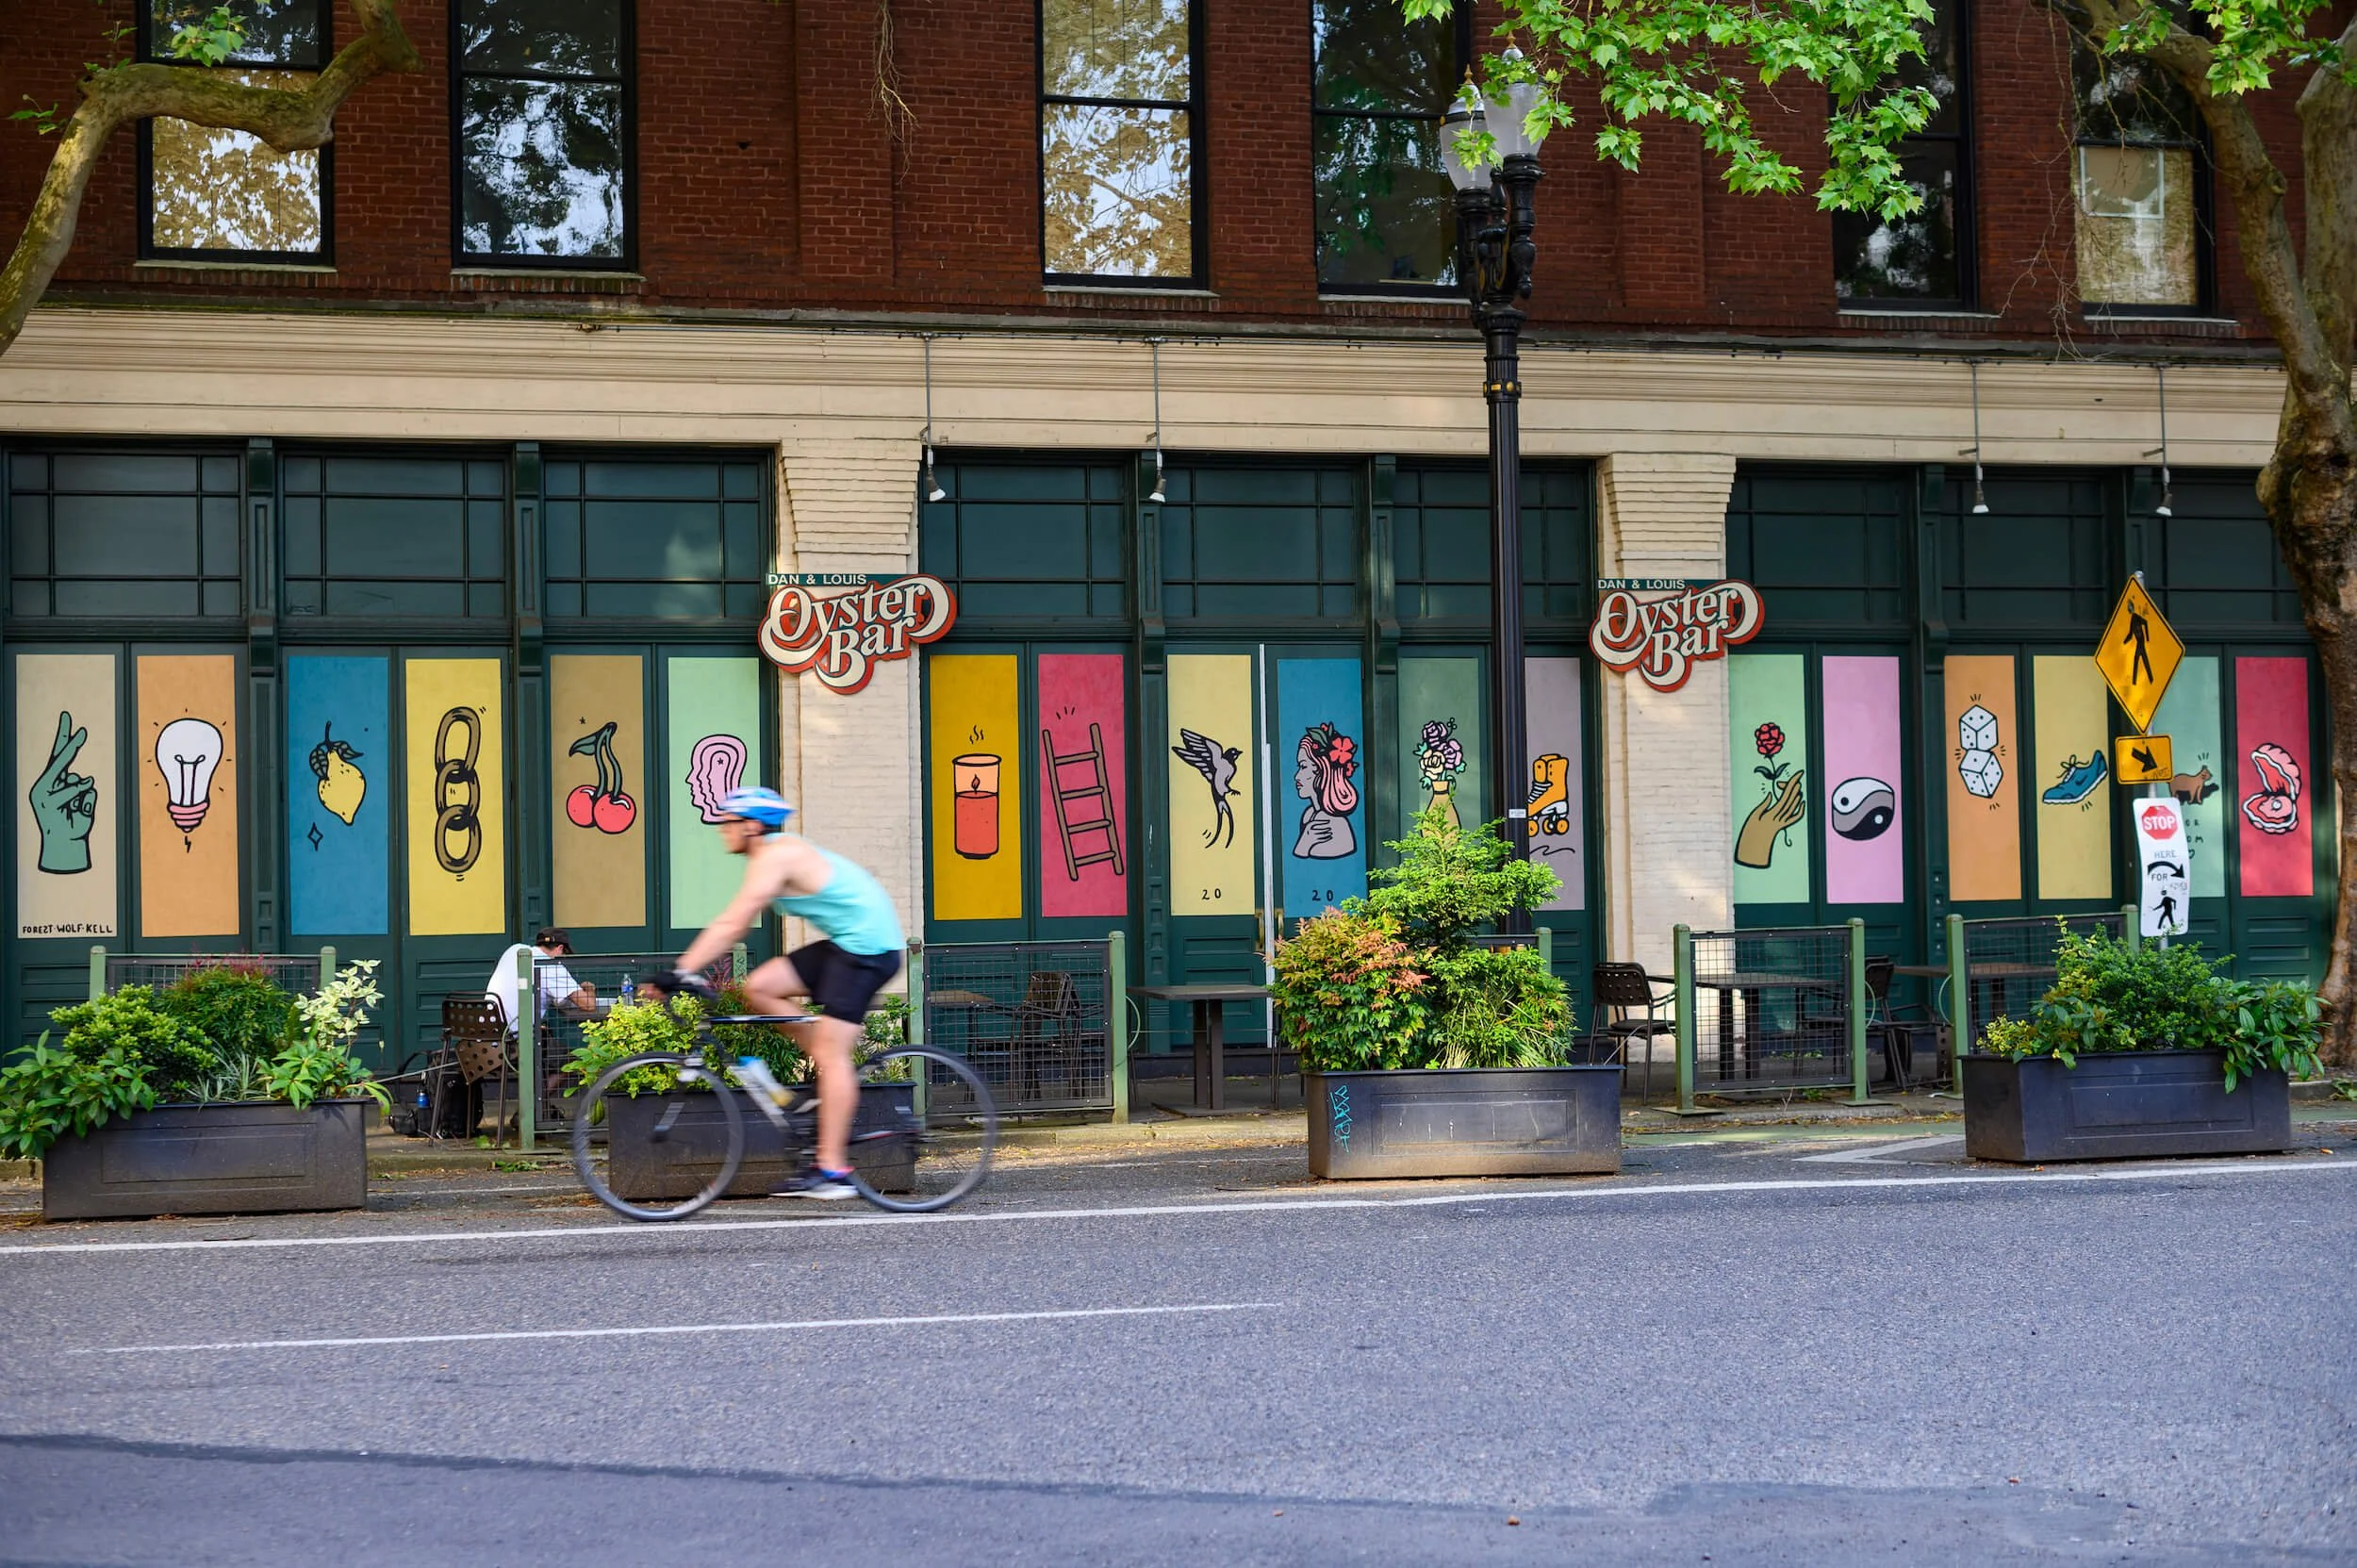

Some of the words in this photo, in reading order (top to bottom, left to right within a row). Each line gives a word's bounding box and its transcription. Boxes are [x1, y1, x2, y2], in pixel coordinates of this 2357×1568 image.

[768, 574, 799, 585] DAN
[806, 574, 816, 585] &
[823, 574, 867, 585] LOUIS
[1598, 579, 1626, 589] DAN
[1631, 579, 1640, 589] &
[1646, 579, 1686, 589] LOUIS
[760, 576, 950, 666] Oyster
[1591, 582, 1760, 666] Oyster
[815, 617, 916, 687] Bar
[1640, 619, 1730, 686] Bar
[2143, 815, 2176, 831] STOP
[2153, 850, 2177, 859] HERE
[2151, 872, 2168, 882] FOR
